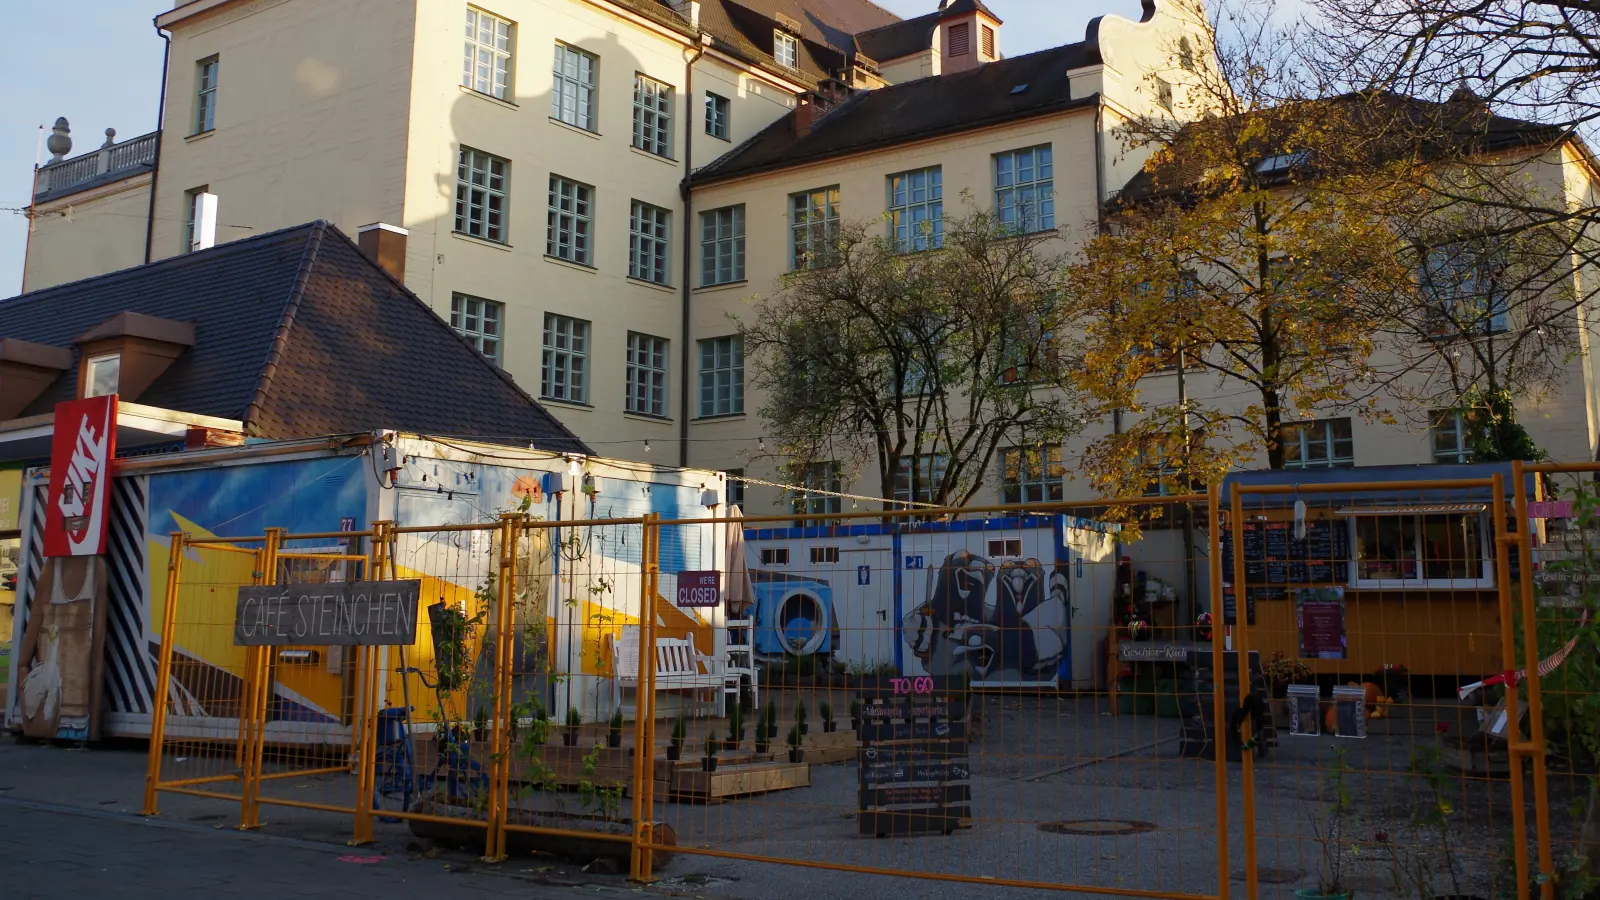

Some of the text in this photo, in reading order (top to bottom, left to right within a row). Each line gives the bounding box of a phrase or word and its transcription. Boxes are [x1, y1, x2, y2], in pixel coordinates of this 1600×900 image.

[58, 413, 103, 517] NIKE
[341, 518, 353, 532] 77
[699, 576, 715, 585] WE'RE
[678, 587, 717, 603] CLOSED
[242, 589, 413, 637] CAFÉ STEINCHEN
[889, 676, 934, 694] TO GO
